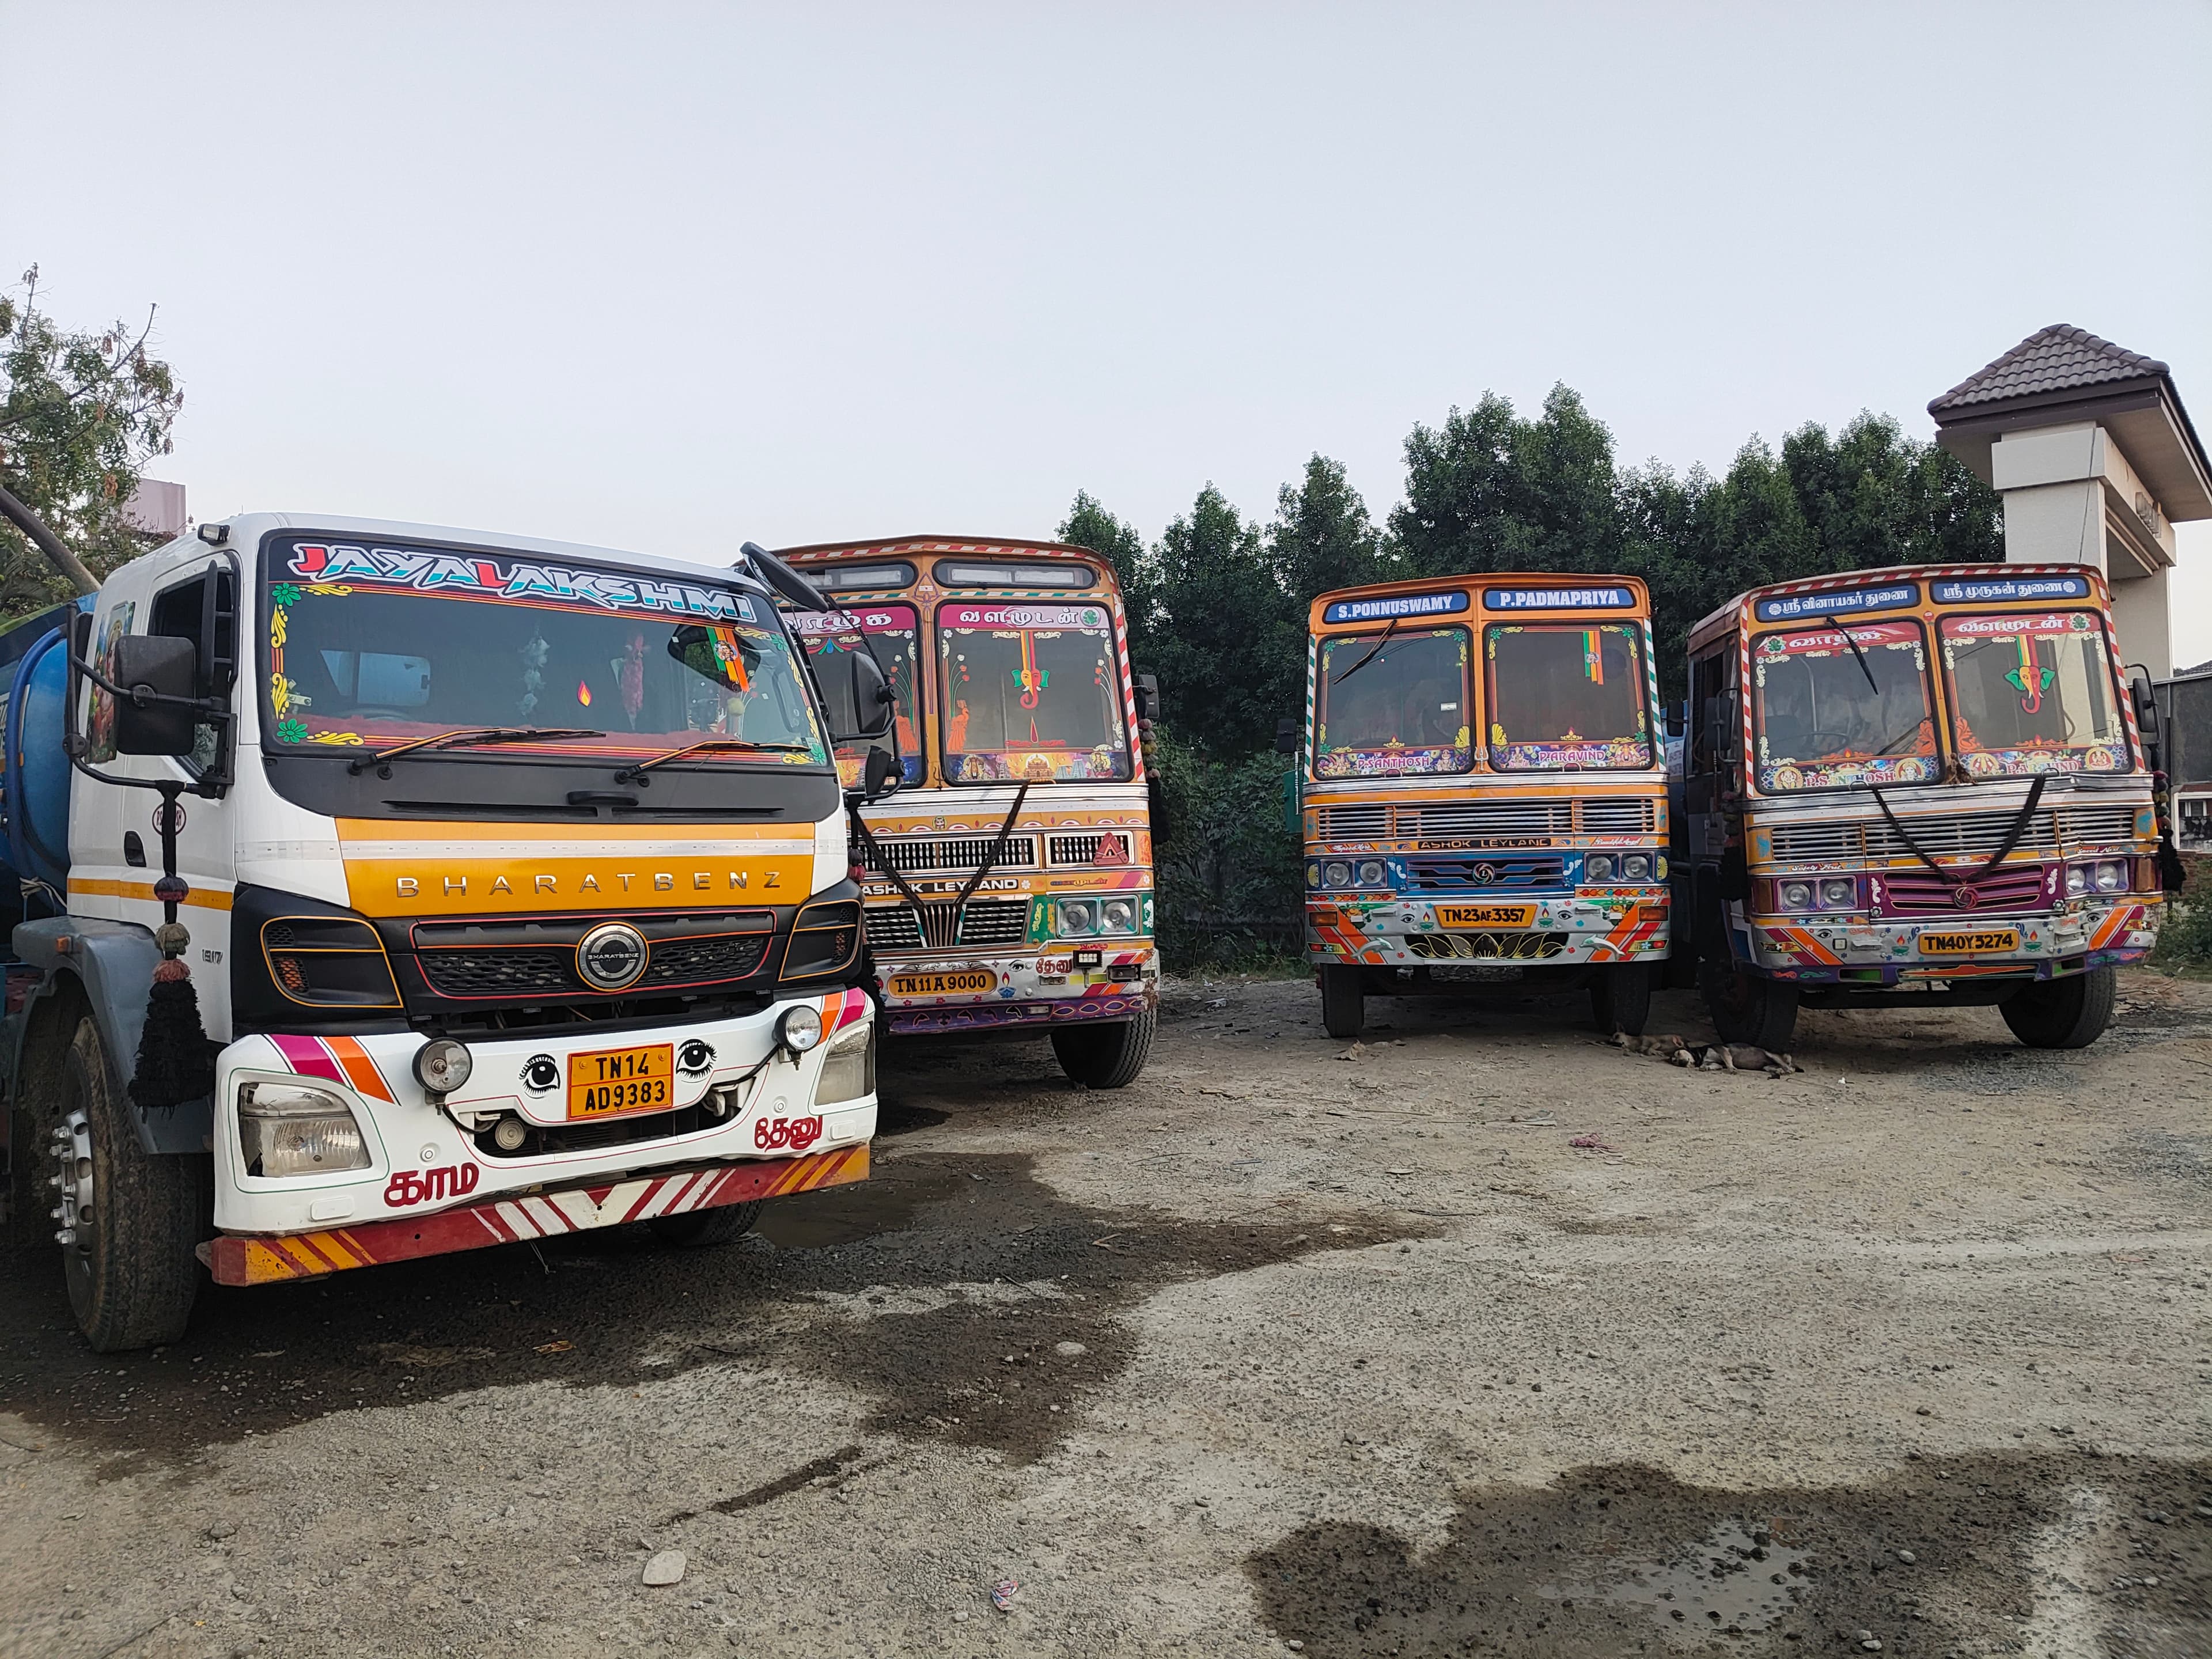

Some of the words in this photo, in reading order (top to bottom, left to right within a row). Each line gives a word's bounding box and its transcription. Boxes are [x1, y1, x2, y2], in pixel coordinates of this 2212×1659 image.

[287, 543, 757, 623] JAYALAKSHMI
[1965, 581, 2016, 598] முருகன்
[2018, 582, 2062, 597] துணை
[1338, 596, 1452, 618] S.PONNUSWAMY
[1499, 590, 1619, 607] P.PADMAPRIYA
[1865, 590, 1908, 606] துணை
[959, 607, 1078, 626] வளமுடன்
[1958, 615, 2065, 632] வளமுடன்
[1358, 756, 1430, 768] P.SANTHOSH
[1539, 751, 1605, 762] P.ARAVIND
[1421, 840, 1471, 849] ASHOK
[396, 871, 781, 897] BHARATBENZ
[933, 879, 1018, 892] LEYAND
[596, 1053, 649, 1080] TN14
[585, 1080, 665, 1111] AD9383
[755, 1115, 823, 1152] தேனு
[384, 1162, 479, 1207] காம
